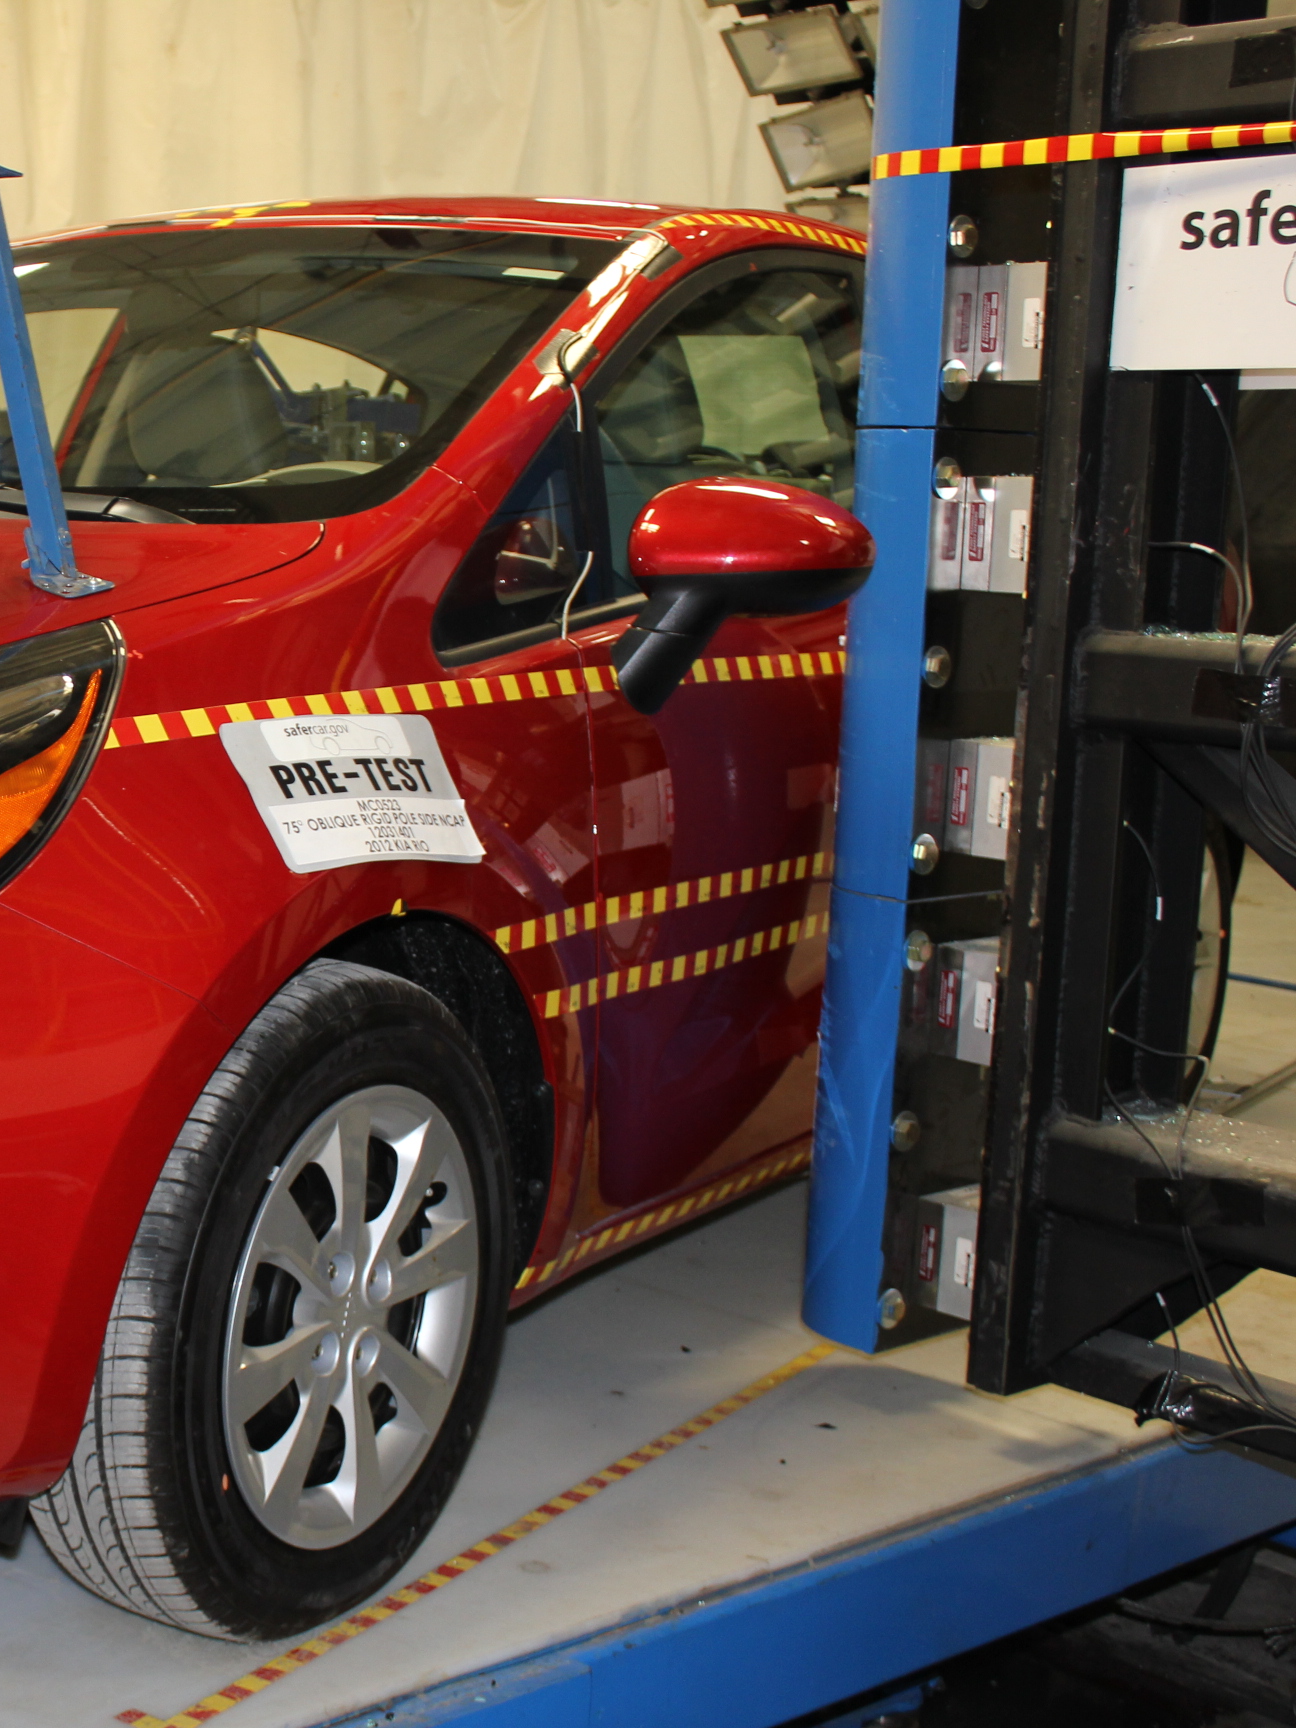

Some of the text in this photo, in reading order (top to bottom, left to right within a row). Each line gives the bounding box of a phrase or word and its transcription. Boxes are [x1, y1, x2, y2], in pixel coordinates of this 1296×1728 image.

[284, 721, 349, 738] safercar.gov
[269, 758, 432, 799] PRE-TEST
[356, 799, 402, 812] MC0523
[307, 814, 360, 831] OBLIQUE
[360, 812, 392, 827] RIGID
[393, 812, 418, 826] POLE
[418, 813, 439, 826] SIDE
[439, 815, 465, 827] NCAP
[368, 827, 416, 839] 12031401
[365, 840, 430, 853] 2012 KIA RIO
